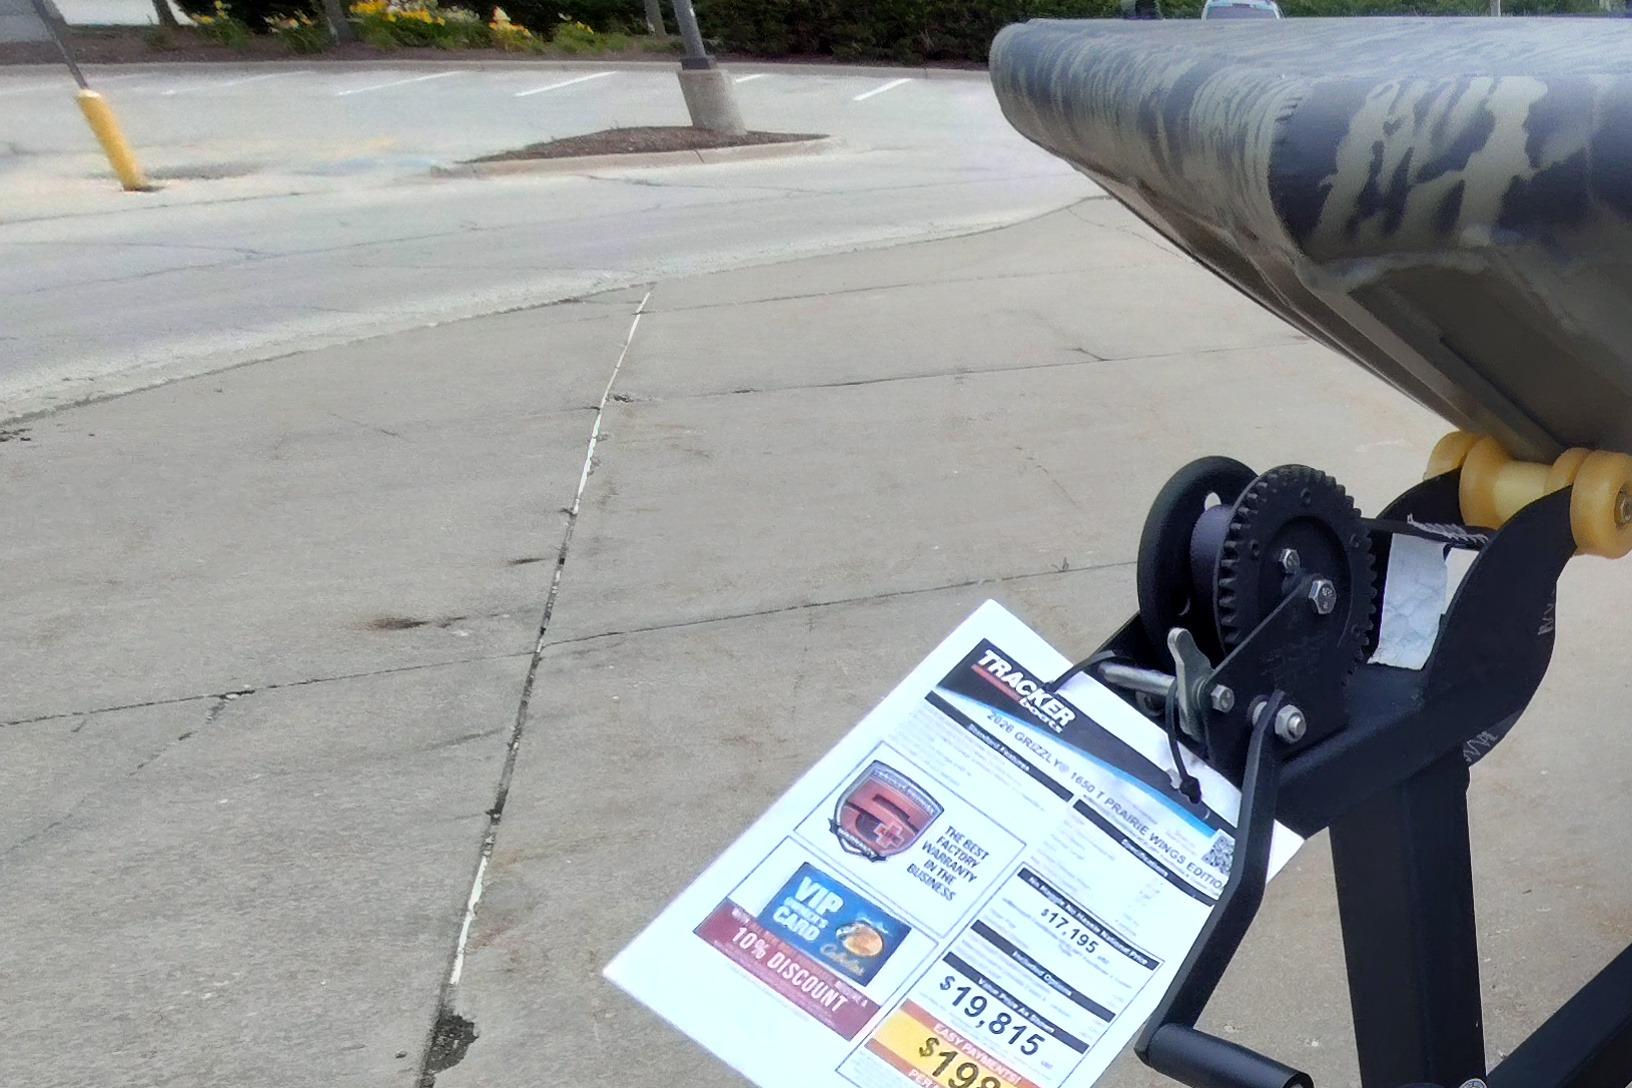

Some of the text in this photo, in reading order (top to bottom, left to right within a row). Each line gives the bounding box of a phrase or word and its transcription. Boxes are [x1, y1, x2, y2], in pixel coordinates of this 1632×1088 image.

[977, 649, 1077, 727] TRACKER
[935, 835, 979, 870] FACTORY
[943, 825, 989, 861] THE BEST
[1068, 771, 1095, 793] 1650
[1095, 790, 1105, 800] T
[1102, 797, 1150, 835] PRAIRIE
[1146, 831, 1187, 865] WINGS
[1186, 861, 1225, 891] EDITIO
[905, 862, 956, 902] BUSINESS
[920, 840, 977, 884] WARRANTY
[922, 859, 956, 885] IN THE
[796, 875, 847, 918] VIP
[772, 904, 822, 944] CARD
[1039, 907, 1099, 954] $17,195
[731, 925, 773, 960] 10%
[766, 950, 848, 1012] DISCOUNT
[940, 976, 1045, 1056] $19,815
[931, 1021, 1022, 1085] EASY PAYMENTS!
[907, 1068, 932, 1088] PER
